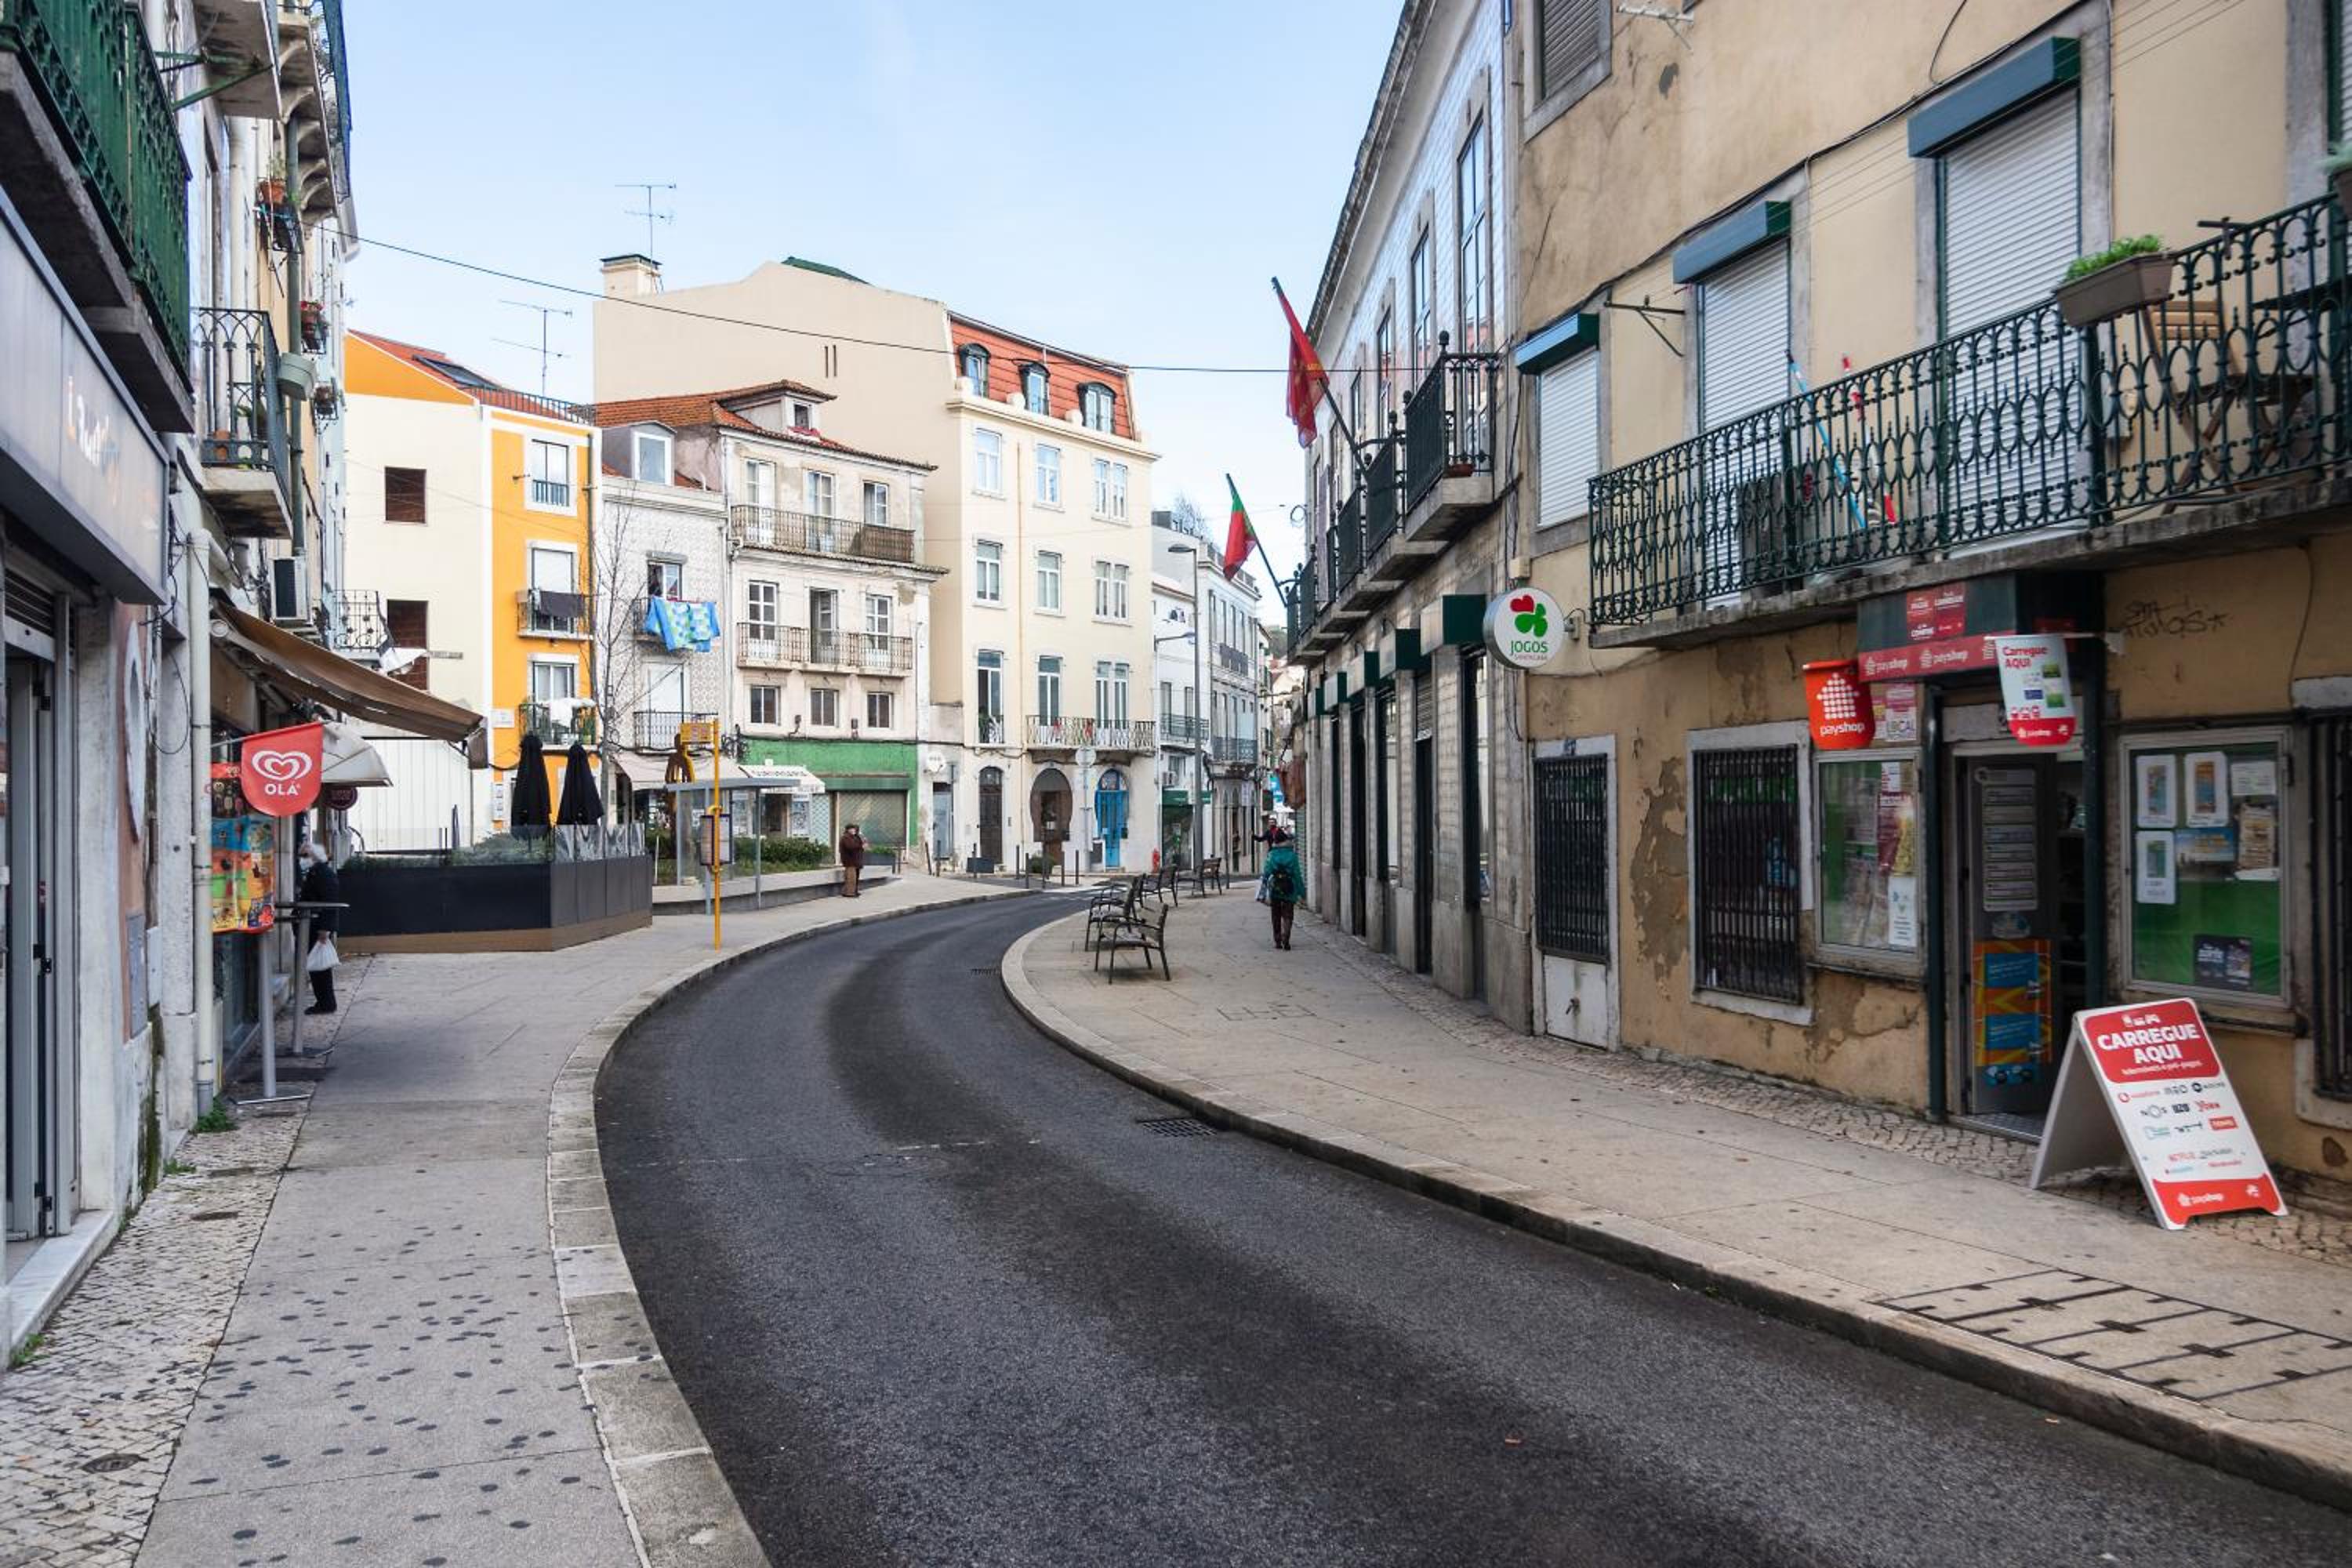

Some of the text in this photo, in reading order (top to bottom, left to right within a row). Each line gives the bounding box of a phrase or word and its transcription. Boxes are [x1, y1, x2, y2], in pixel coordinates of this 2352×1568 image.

[1510, 640, 1548, 656] JOGOS
[2005, 658, 2032, 670] AQUI
[1820, 720, 1865, 736] payshop
[264, 780, 299, 796] OLÁ
[2097, 1024, 2201, 1050] CARREGUE
[2133, 1044, 2183, 1064] AQUI
